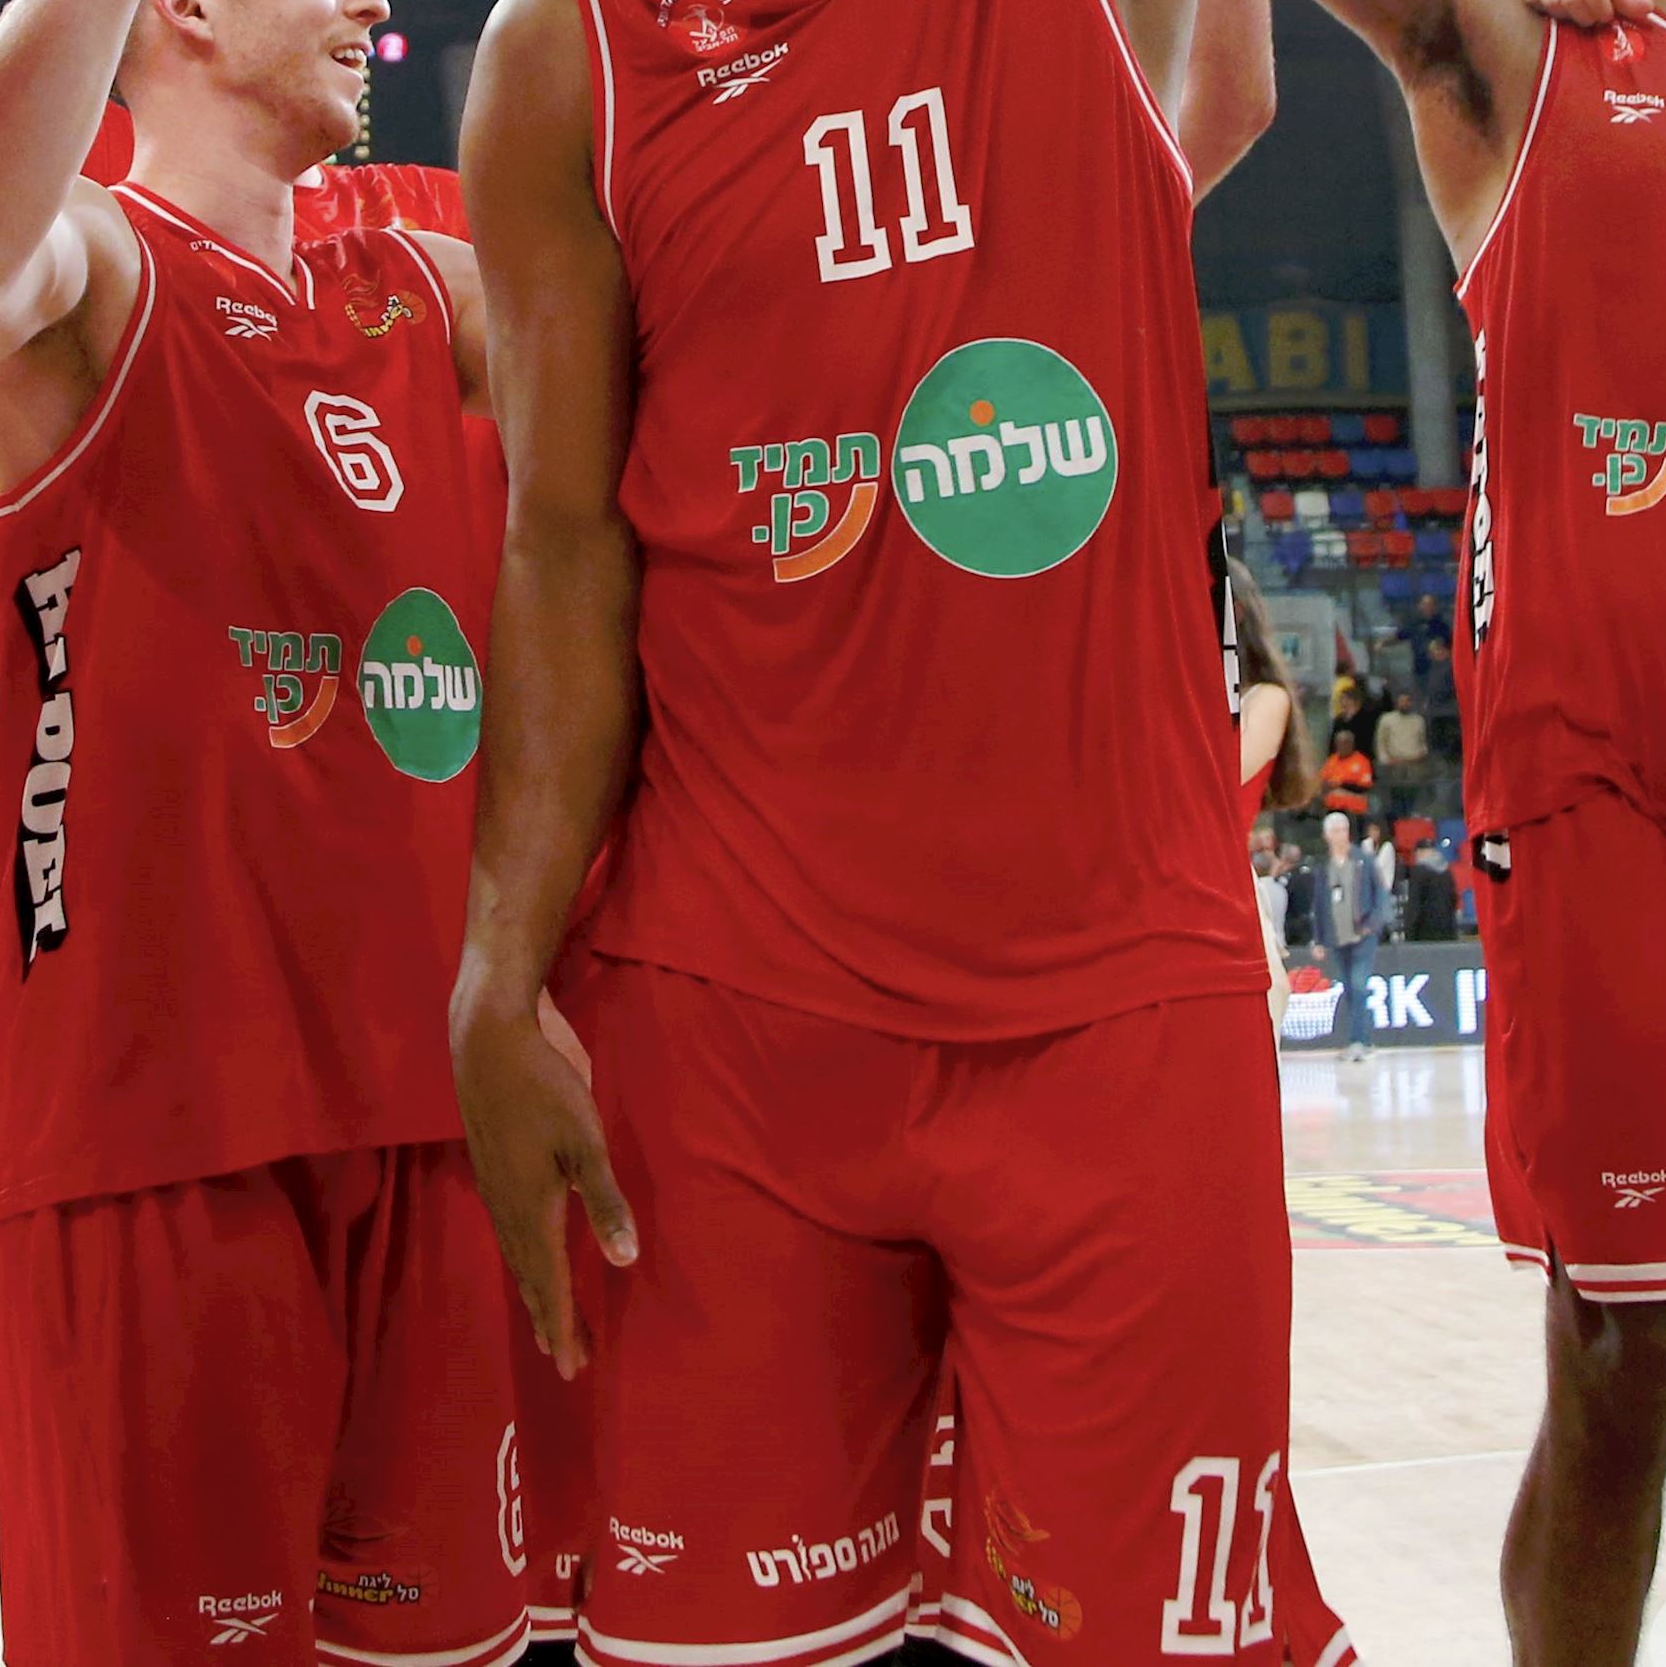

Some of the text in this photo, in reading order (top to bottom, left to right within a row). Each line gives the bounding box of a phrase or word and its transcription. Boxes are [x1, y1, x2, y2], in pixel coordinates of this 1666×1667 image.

[696, 41, 790, 88] Reebok
[1603, 89, 1666, 109] Reebok
[802, 86, 976, 284] 11
[303, 390, 405, 512] 6
[730, 431, 881, 494] תמיד
[898, 414, 1109, 504] שלמה
[229, 625, 343, 674] תמיד
[363, 657, 478, 713] שלמה
[609, 1515, 685, 1551] Reebok
[198, 1589, 283, 1617] Reebok
